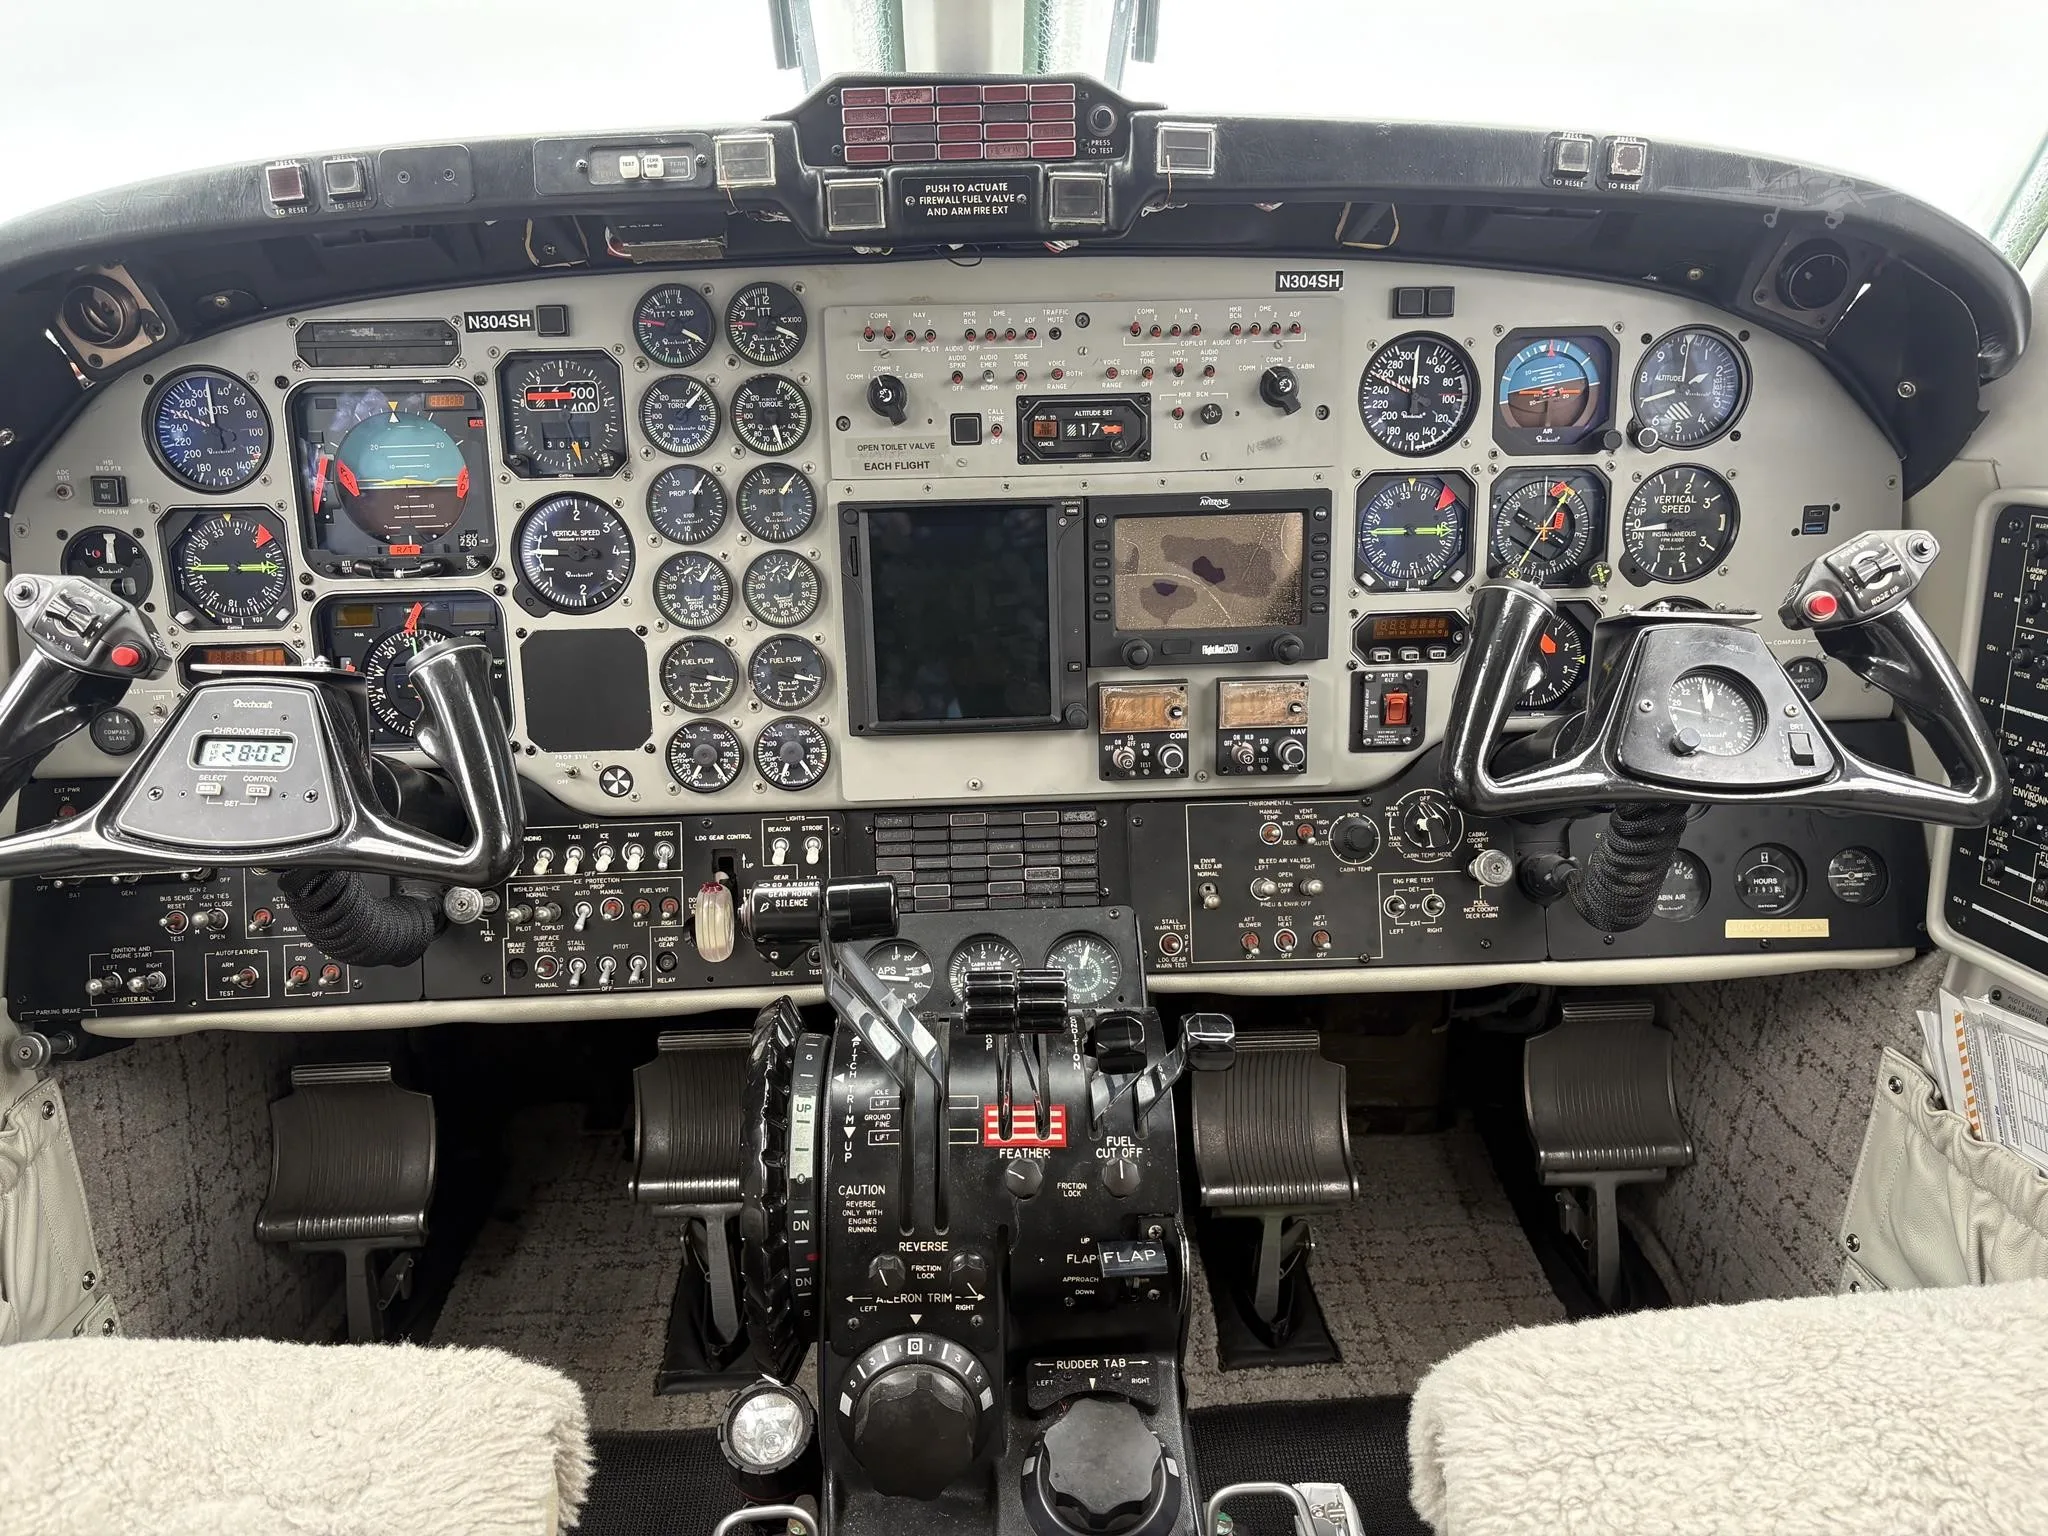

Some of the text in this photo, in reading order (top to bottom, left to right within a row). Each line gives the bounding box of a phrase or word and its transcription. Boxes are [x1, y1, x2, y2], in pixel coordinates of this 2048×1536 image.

[1091, 139, 1111, 147] PRESS
[1088, 146, 1113, 155] TO TEST
[925, 182, 1009, 193] PUSH TO ACTUATE
[1564, 179, 1584, 188] RESET
[1607, 182, 1639, 191] TO RESET
[919, 194, 1015, 205] FIREWALL FUEL VALVE
[275, 206, 309, 215] TO RESET
[926, 205, 1009, 216] AND ARM FIRE EXT
[1279, 275, 1340, 288] N304SH
[757, 307, 772, 316] ITT
[468, 313, 531, 330] N304SH
[217, 387, 230, 396] 40
[569, 387, 596, 400] 500
[1203, 410, 1221, 420] VOL
[249, 428, 264, 437] 100
[174, 437, 192, 446] 220
[857, 442, 936, 452] OPEN TOILET VALVE
[184, 450, 202, 459] 200
[864, 461, 930, 471] EACH FLIGHT
[218, 468, 233, 477] 160
[1654, 495, 1697, 504] VERTICAL
[1634, 507, 1647, 516] UP
[1661, 504, 1691, 514] SPEED
[551, 529, 600, 537] VERTICAL SPEED
[396, 546, 415, 554] R/T
[2026, 567, 2048, 576] LANDING
[2020, 632, 2035, 640] FLAP
[2013, 671, 2030, 679] MOTOR
[213, 726, 281, 736] CHRONOMETER
[198, 774, 279, 783] SELECT CONTROL
[223, 800, 240, 808] SET
[1753, 877, 1778, 885] HOURS
[775, 899, 808, 907] SILENCE
[849, 1041, 860, 1078] PITCH
[875, 1120, 891, 1128] FINE
[1106, 1136, 1135, 1147] FUEL
[999, 1147, 1051, 1159] FEATHER
[1095, 1147, 1143, 1159] CUT OFF
[838, 1185, 886, 1196] CAUTION
[1057, 1182, 1087, 1190] FRICTION
[846, 1200, 876, 1208] REVERSE
[866, 1208, 883, 1216] WITH
[792, 1220, 810, 1231] DN
[898, 1241, 949, 1252] REVERSE
[1103, 1250, 1156, 1264] FLAP
[916, 1272, 935, 1280] LOCK
[1056, 1358, 1126, 1370] RUDDER TAB
